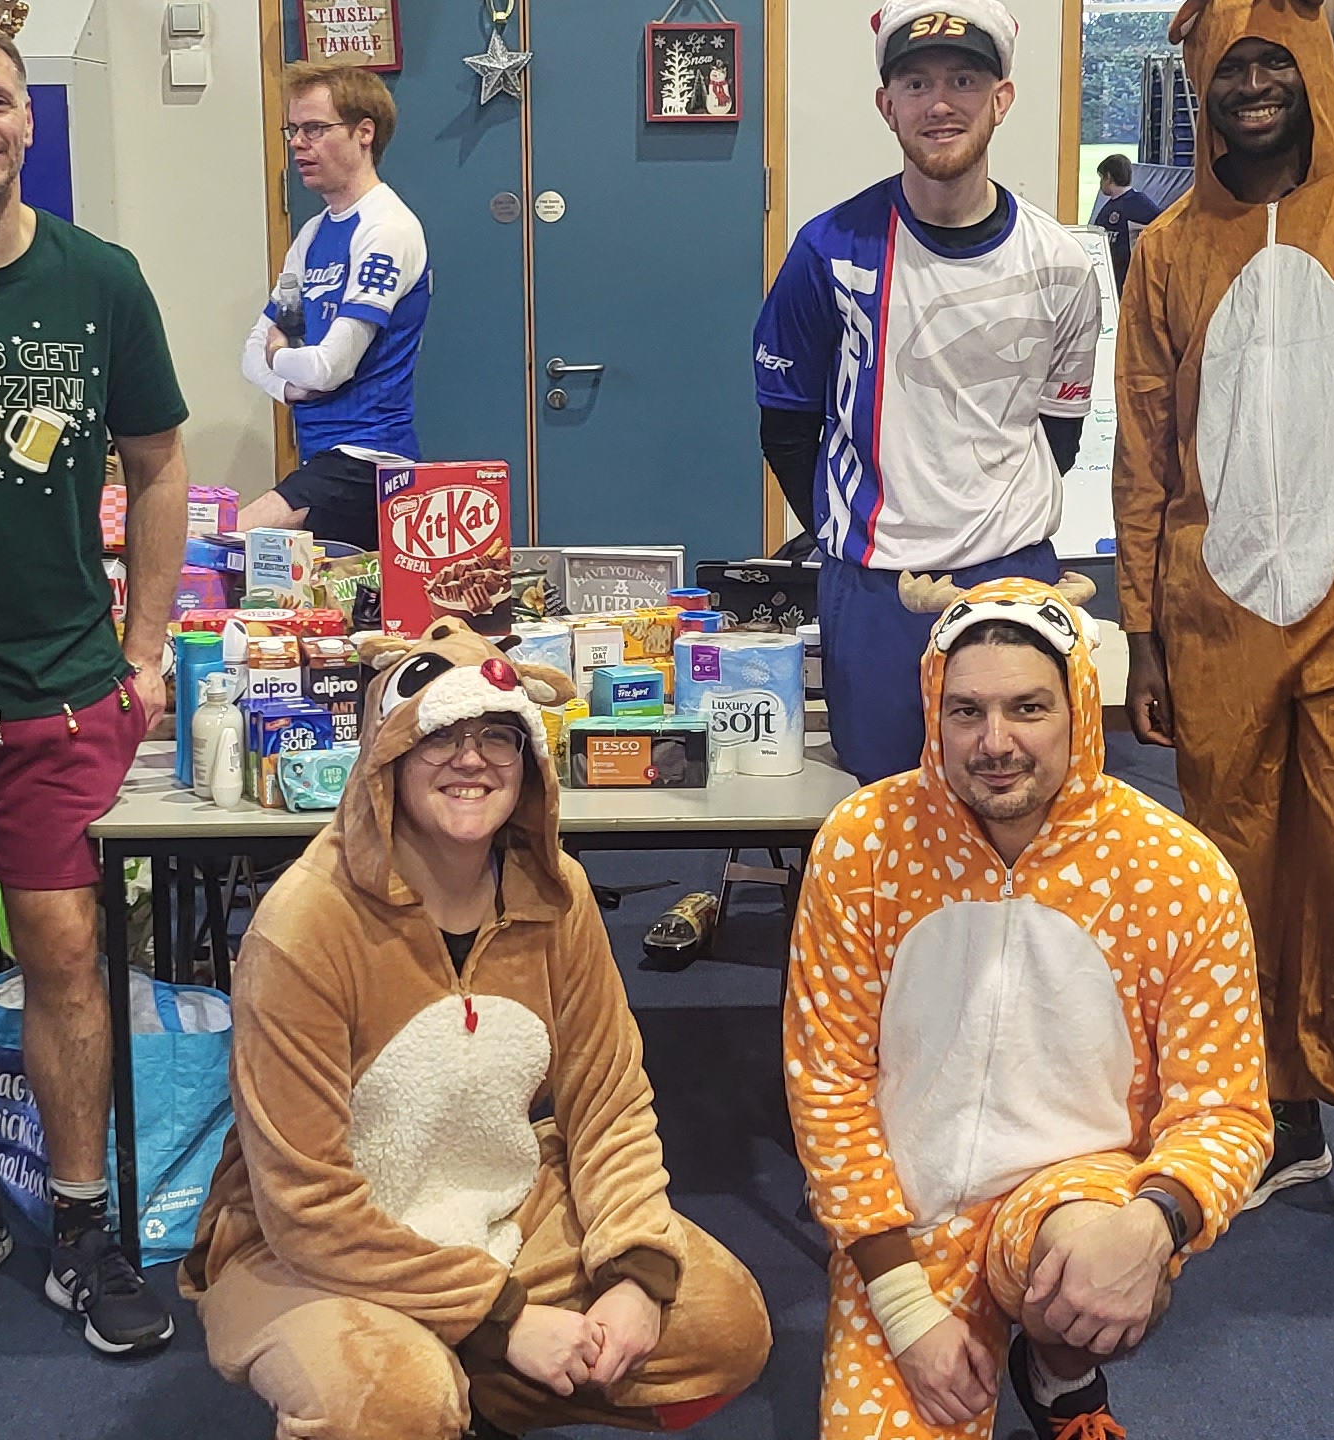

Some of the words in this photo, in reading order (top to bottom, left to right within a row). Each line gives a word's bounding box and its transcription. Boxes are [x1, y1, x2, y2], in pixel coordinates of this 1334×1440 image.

[316, 6, 377, 23] TINSEL
[317, 34, 382, 53] TANGLE
[683, 52, 714, 66] Snow
[18, 341, 85, 372] GET
[384, 470, 411, 496] NEW
[394, 553, 432, 574] CEREAL
[573, 566, 608, 588] HAVE
[607, 565, 668, 596] YOURSELF
[612, 579, 630, 595] A
[580, 593, 660, 613] MERRY
[592, 652, 607, 660] OAT
[252, 680, 298, 697] alpro
[313, 679, 358, 698] alpro
[711, 699, 754, 713] Luxury
[711, 700, 777, 743] soft
[280, 738, 318, 751] SOUP
[592, 741, 641, 752] TESCO
[646, 768, 655, 778] 6
[167, 1185, 204, 1199] contains
